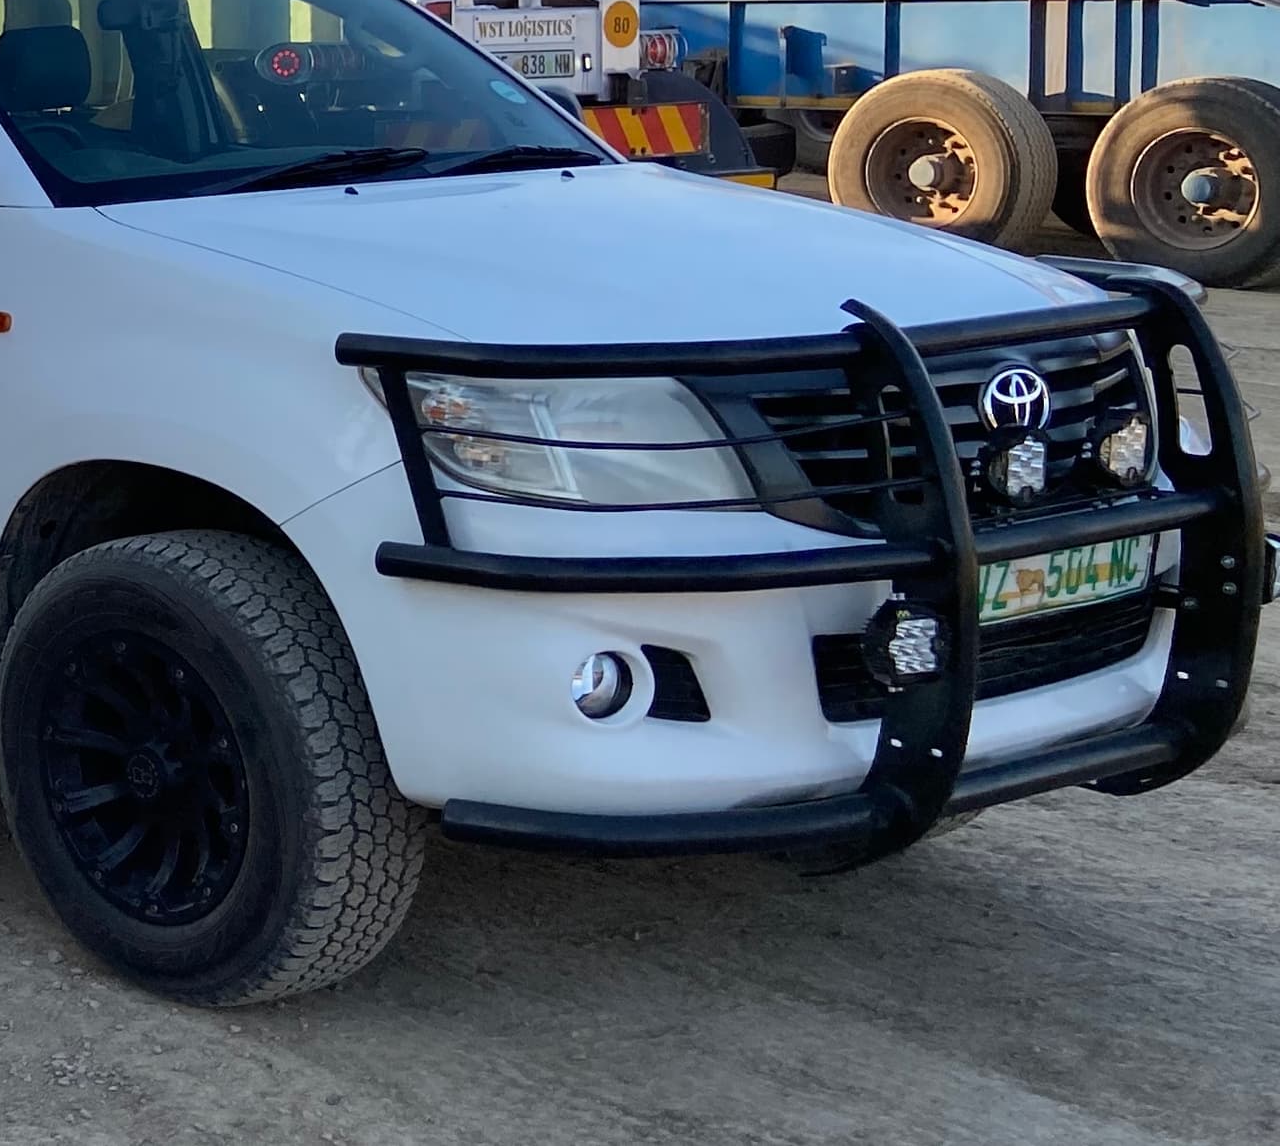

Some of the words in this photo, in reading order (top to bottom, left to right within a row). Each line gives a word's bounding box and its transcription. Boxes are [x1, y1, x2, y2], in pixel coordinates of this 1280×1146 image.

[478, 21, 505, 38] WST
[508, 18, 573, 38] LOGISTICS
[613, 17, 630, 34] 80
[521, 54, 546, 74] 838
[1109, 537, 1141, 588] NC
